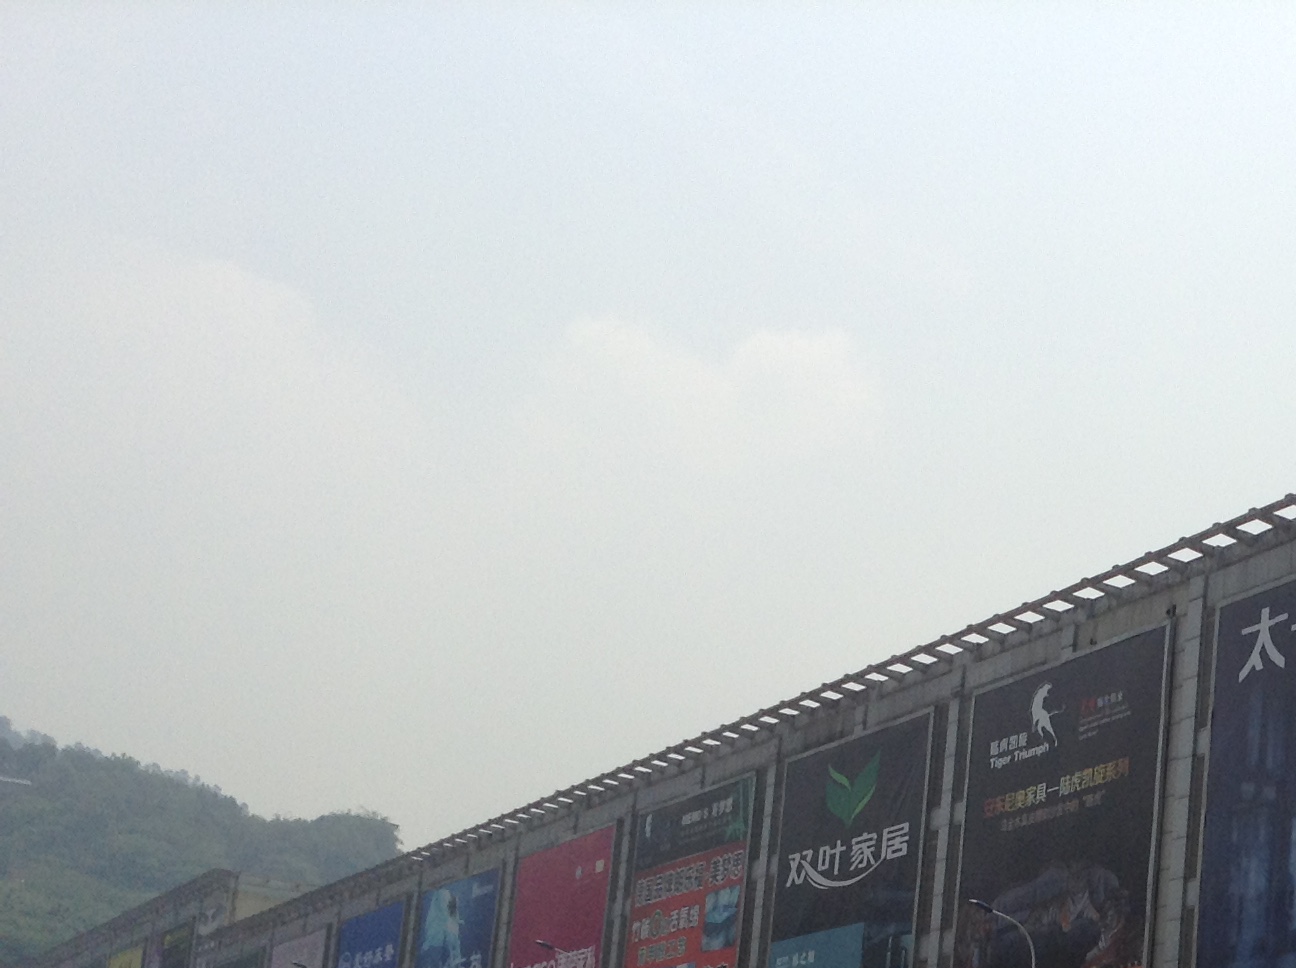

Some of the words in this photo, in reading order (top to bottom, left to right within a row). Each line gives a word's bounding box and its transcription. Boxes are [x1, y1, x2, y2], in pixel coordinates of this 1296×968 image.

[1014, 742, 1049, 761] Triumph
[786, 822, 910, 888] 双叶家居
